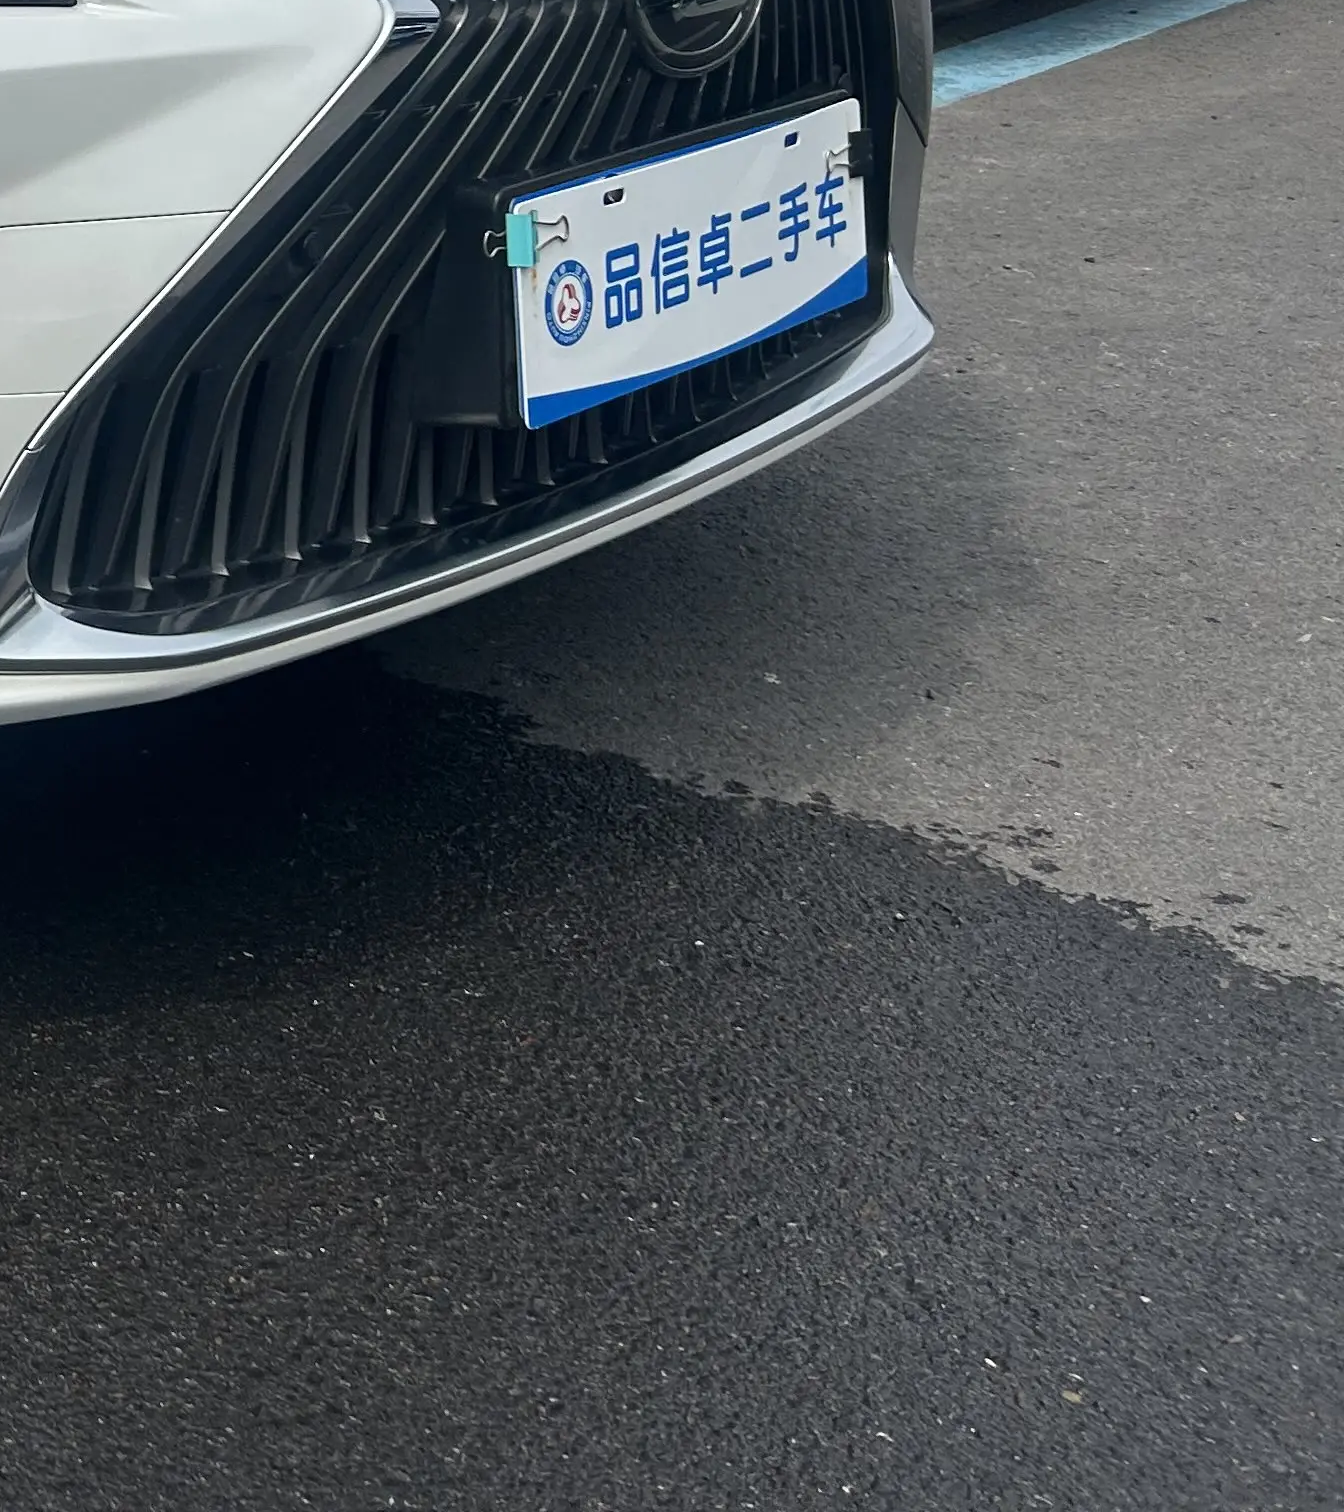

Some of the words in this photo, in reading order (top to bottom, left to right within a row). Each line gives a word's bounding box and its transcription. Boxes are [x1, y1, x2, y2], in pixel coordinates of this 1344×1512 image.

[604, 174, 848, 330] 品信卓二手车
